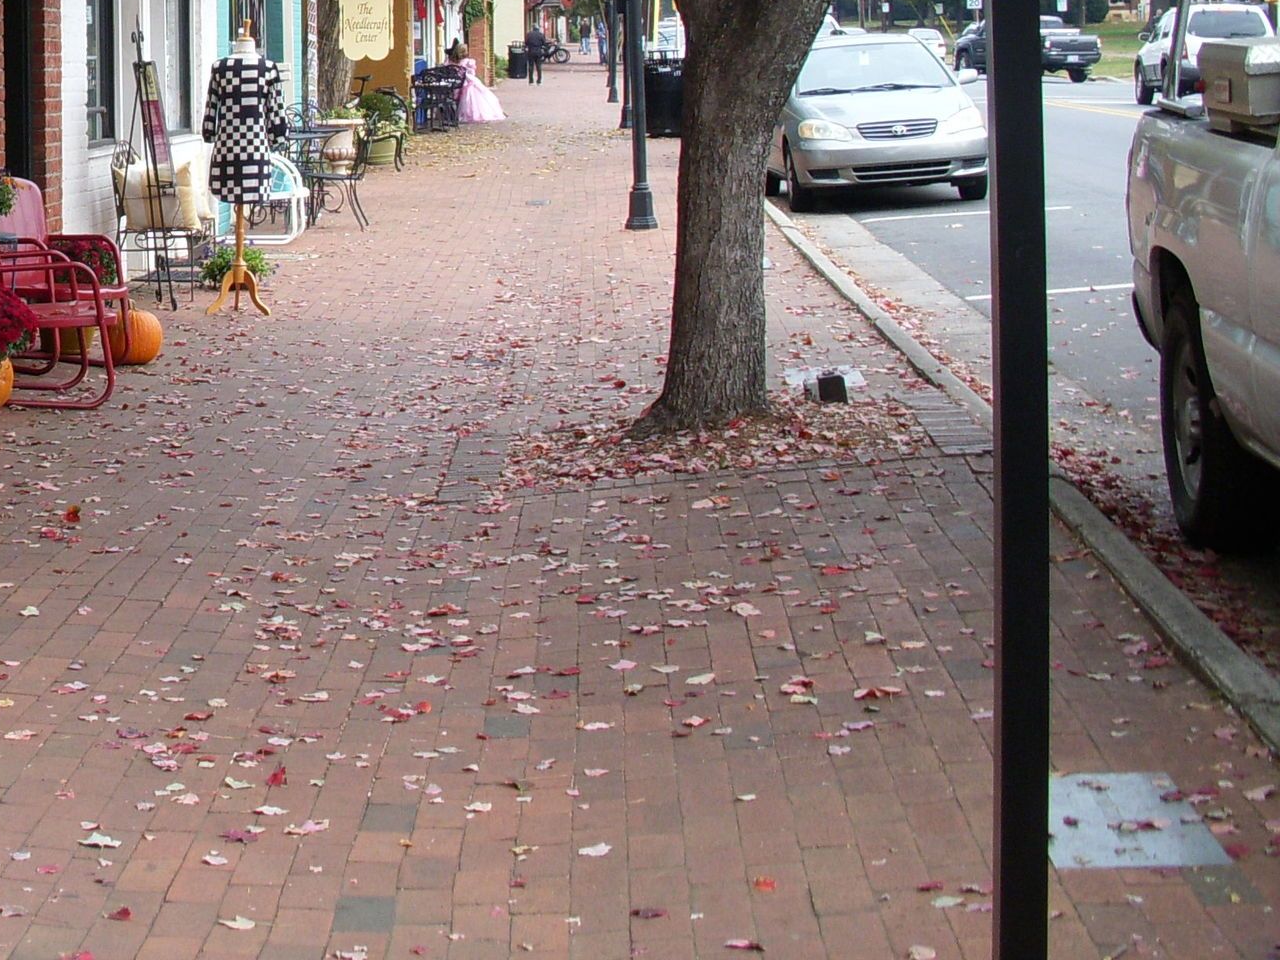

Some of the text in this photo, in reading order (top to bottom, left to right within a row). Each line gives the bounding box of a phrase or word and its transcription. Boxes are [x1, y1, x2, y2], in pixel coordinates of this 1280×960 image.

[357, 1, 374, 15] The
[969, 0, 980, 7] 20
[344, 16, 388, 34] Needlecraft
[355, 31, 378, 44] Center
